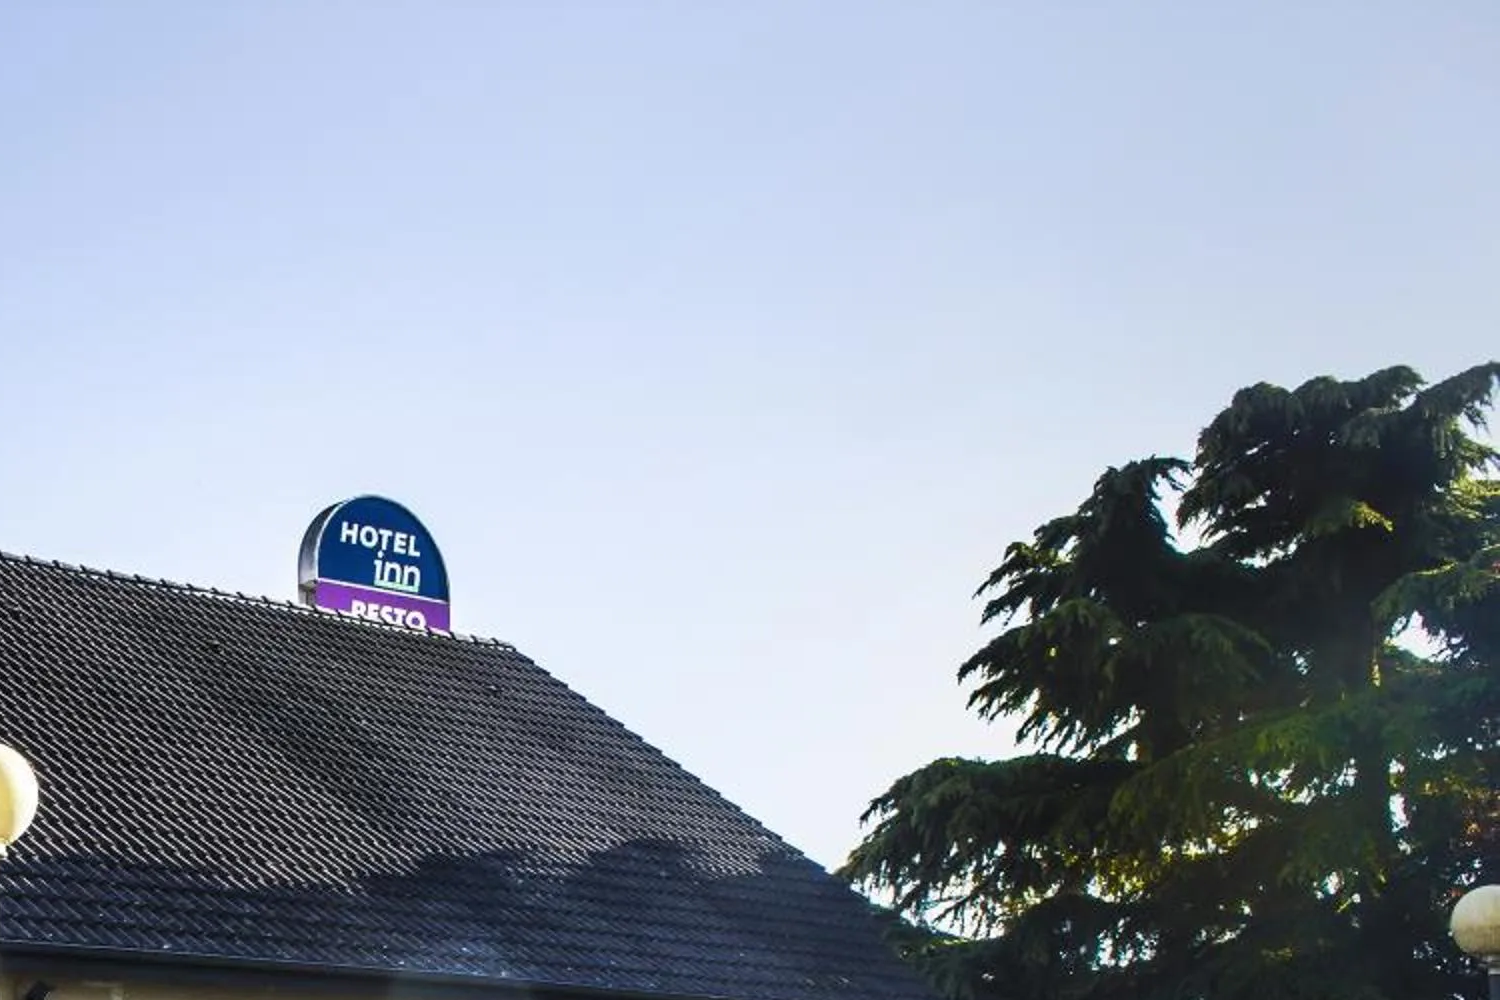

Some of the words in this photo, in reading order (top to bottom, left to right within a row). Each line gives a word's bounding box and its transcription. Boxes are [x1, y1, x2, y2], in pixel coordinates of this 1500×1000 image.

[340, 521, 421, 557] HOTEL
[373, 550, 421, 588] inn
[351, 600, 427, 630] RESTO
